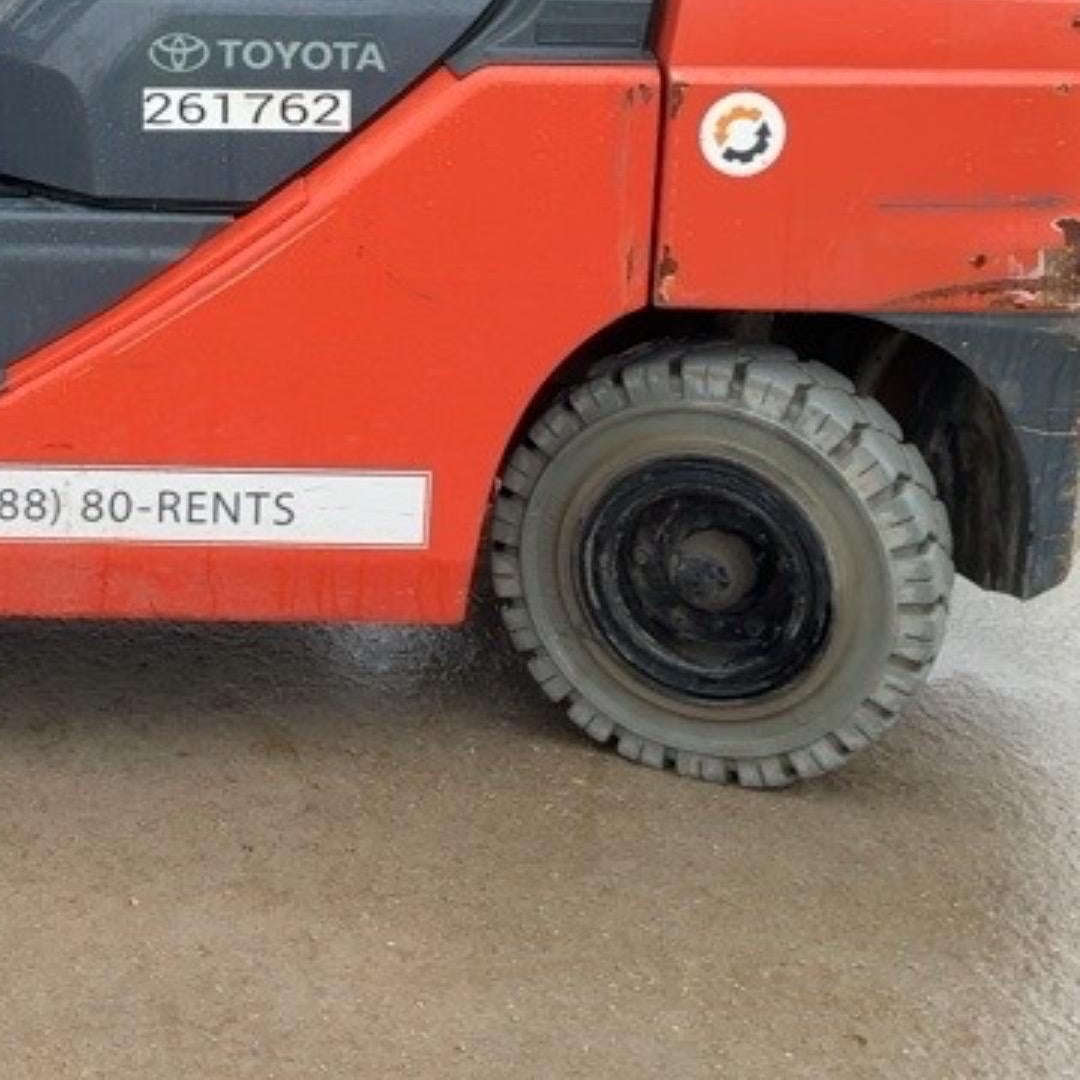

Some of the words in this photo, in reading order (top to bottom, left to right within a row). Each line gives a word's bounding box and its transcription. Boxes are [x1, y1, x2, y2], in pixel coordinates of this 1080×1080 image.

[216, 39, 386, 72] TOYOTA
[145, 92, 342, 126] 261762
[80, 488, 296, 526] 80-RENTS
